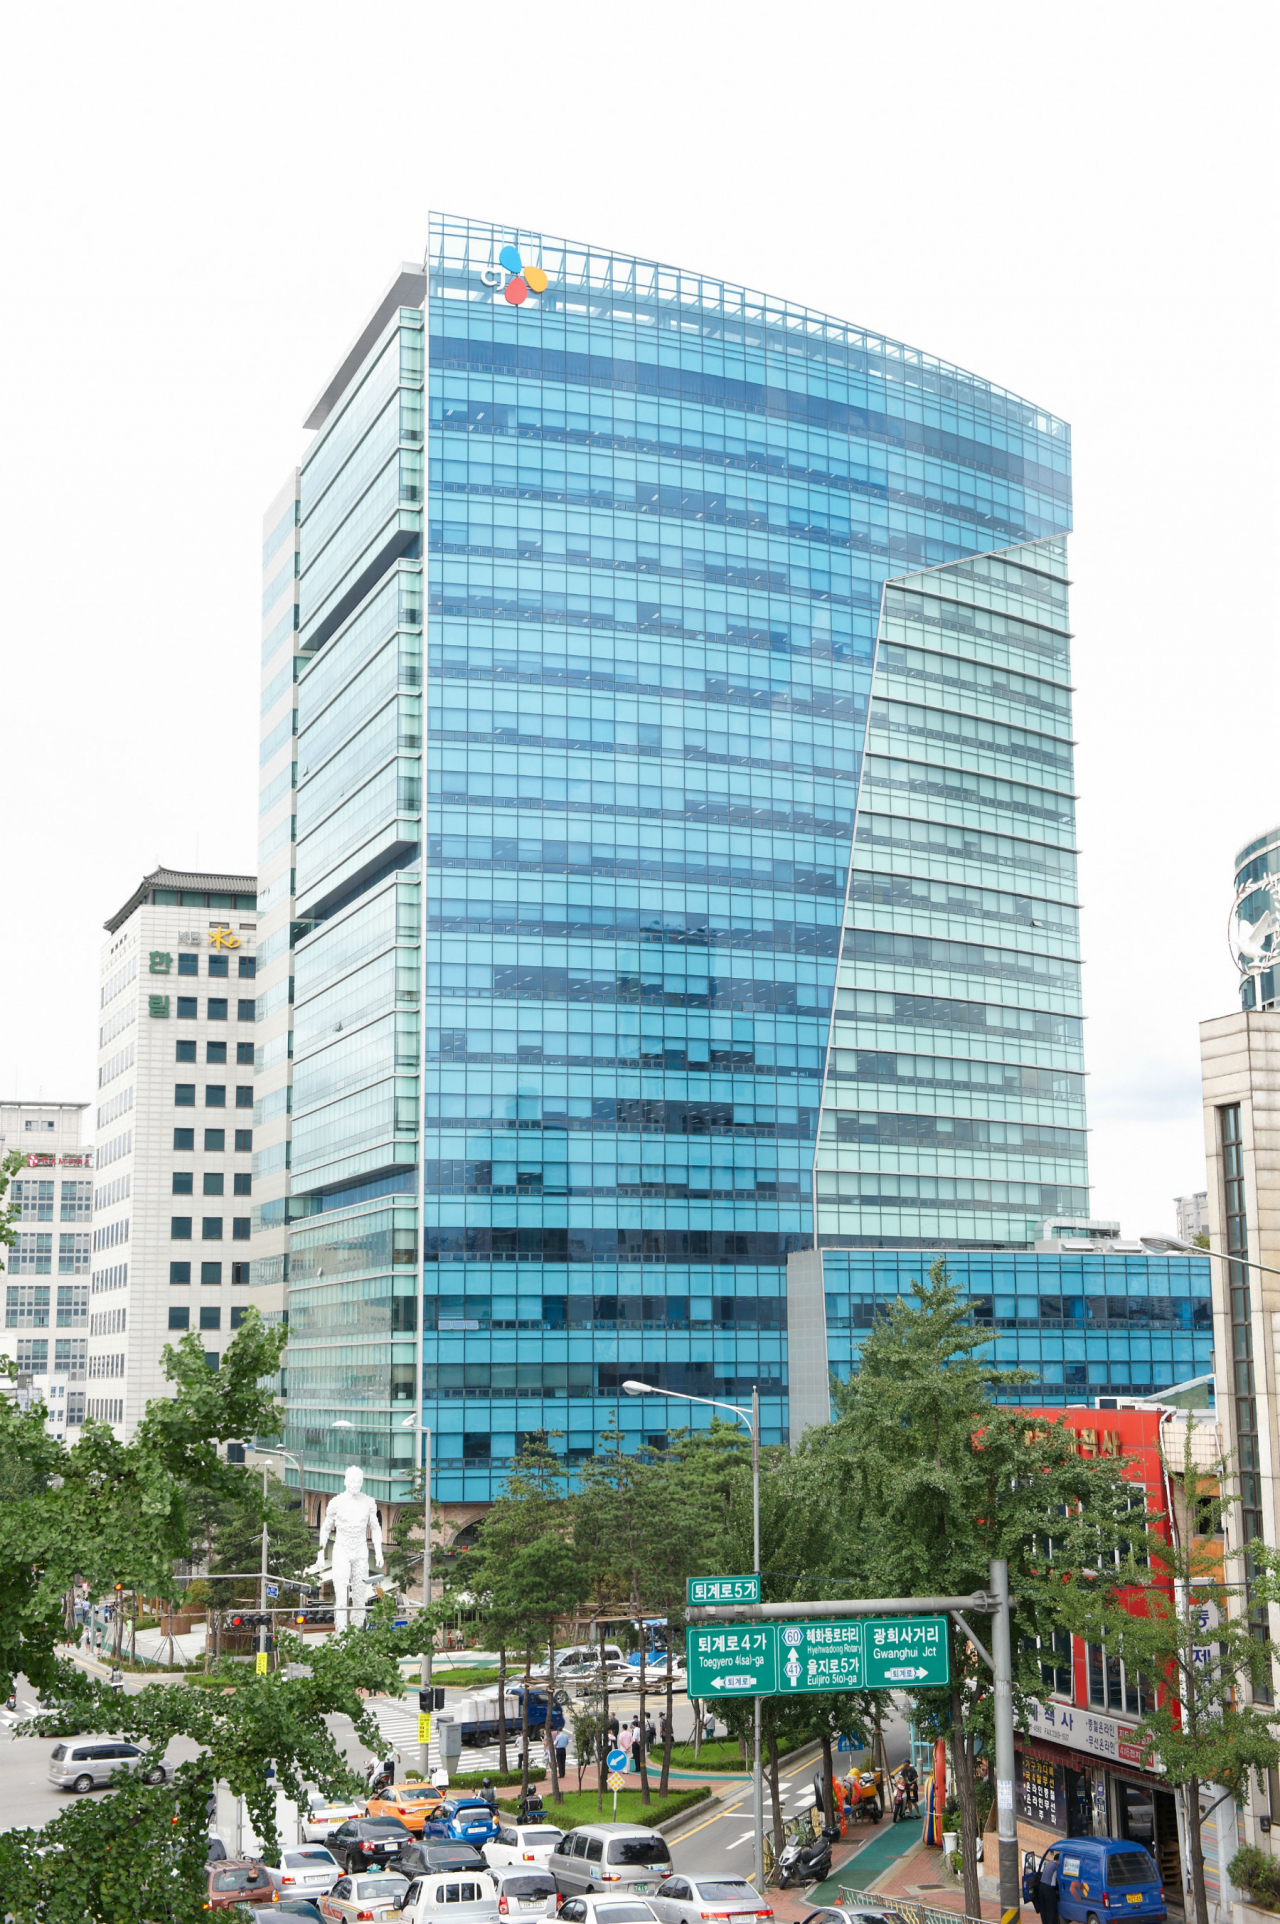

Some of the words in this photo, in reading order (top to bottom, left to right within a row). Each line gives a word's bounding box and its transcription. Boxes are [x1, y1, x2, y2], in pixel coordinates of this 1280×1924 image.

[178, 930, 201, 945] KB
[148, 950, 173, 1018] 한림
[42, 1155, 90, 1165] RAMADA
[694, 1581, 757, 1600] 퇴계로5가
[787, 1631, 799, 1643] 60
[806, 1626, 859, 1644] 혜화동로터리
[873, 1626, 939, 1645] 광희사거리
[697, 1633, 767, 1653] 퇴계로4가
[807, 1645, 843, 1656] Hyehwadong
[844, 1643, 862, 1654] Rotary
[873, 1647, 918, 1660] Gwanghui
[922, 1646, 937, 1657] Jct
[699, 1656, 734, 1670] Toegyero
[734, 1656, 765, 1668] 4(sa)-ga
[788, 1664, 799, 1675] 41
[807, 1657, 859, 1675] 을지로5가
[807, 1674, 830, 1687] Euljiro
[832, 1673, 857, 1685] 5(o)-ga
[892, 1668, 913, 1679] 퇴계로
[727, 1676, 749, 1687] 퇴계로
[1088, 1735, 1116, 1755] 무선온라인
